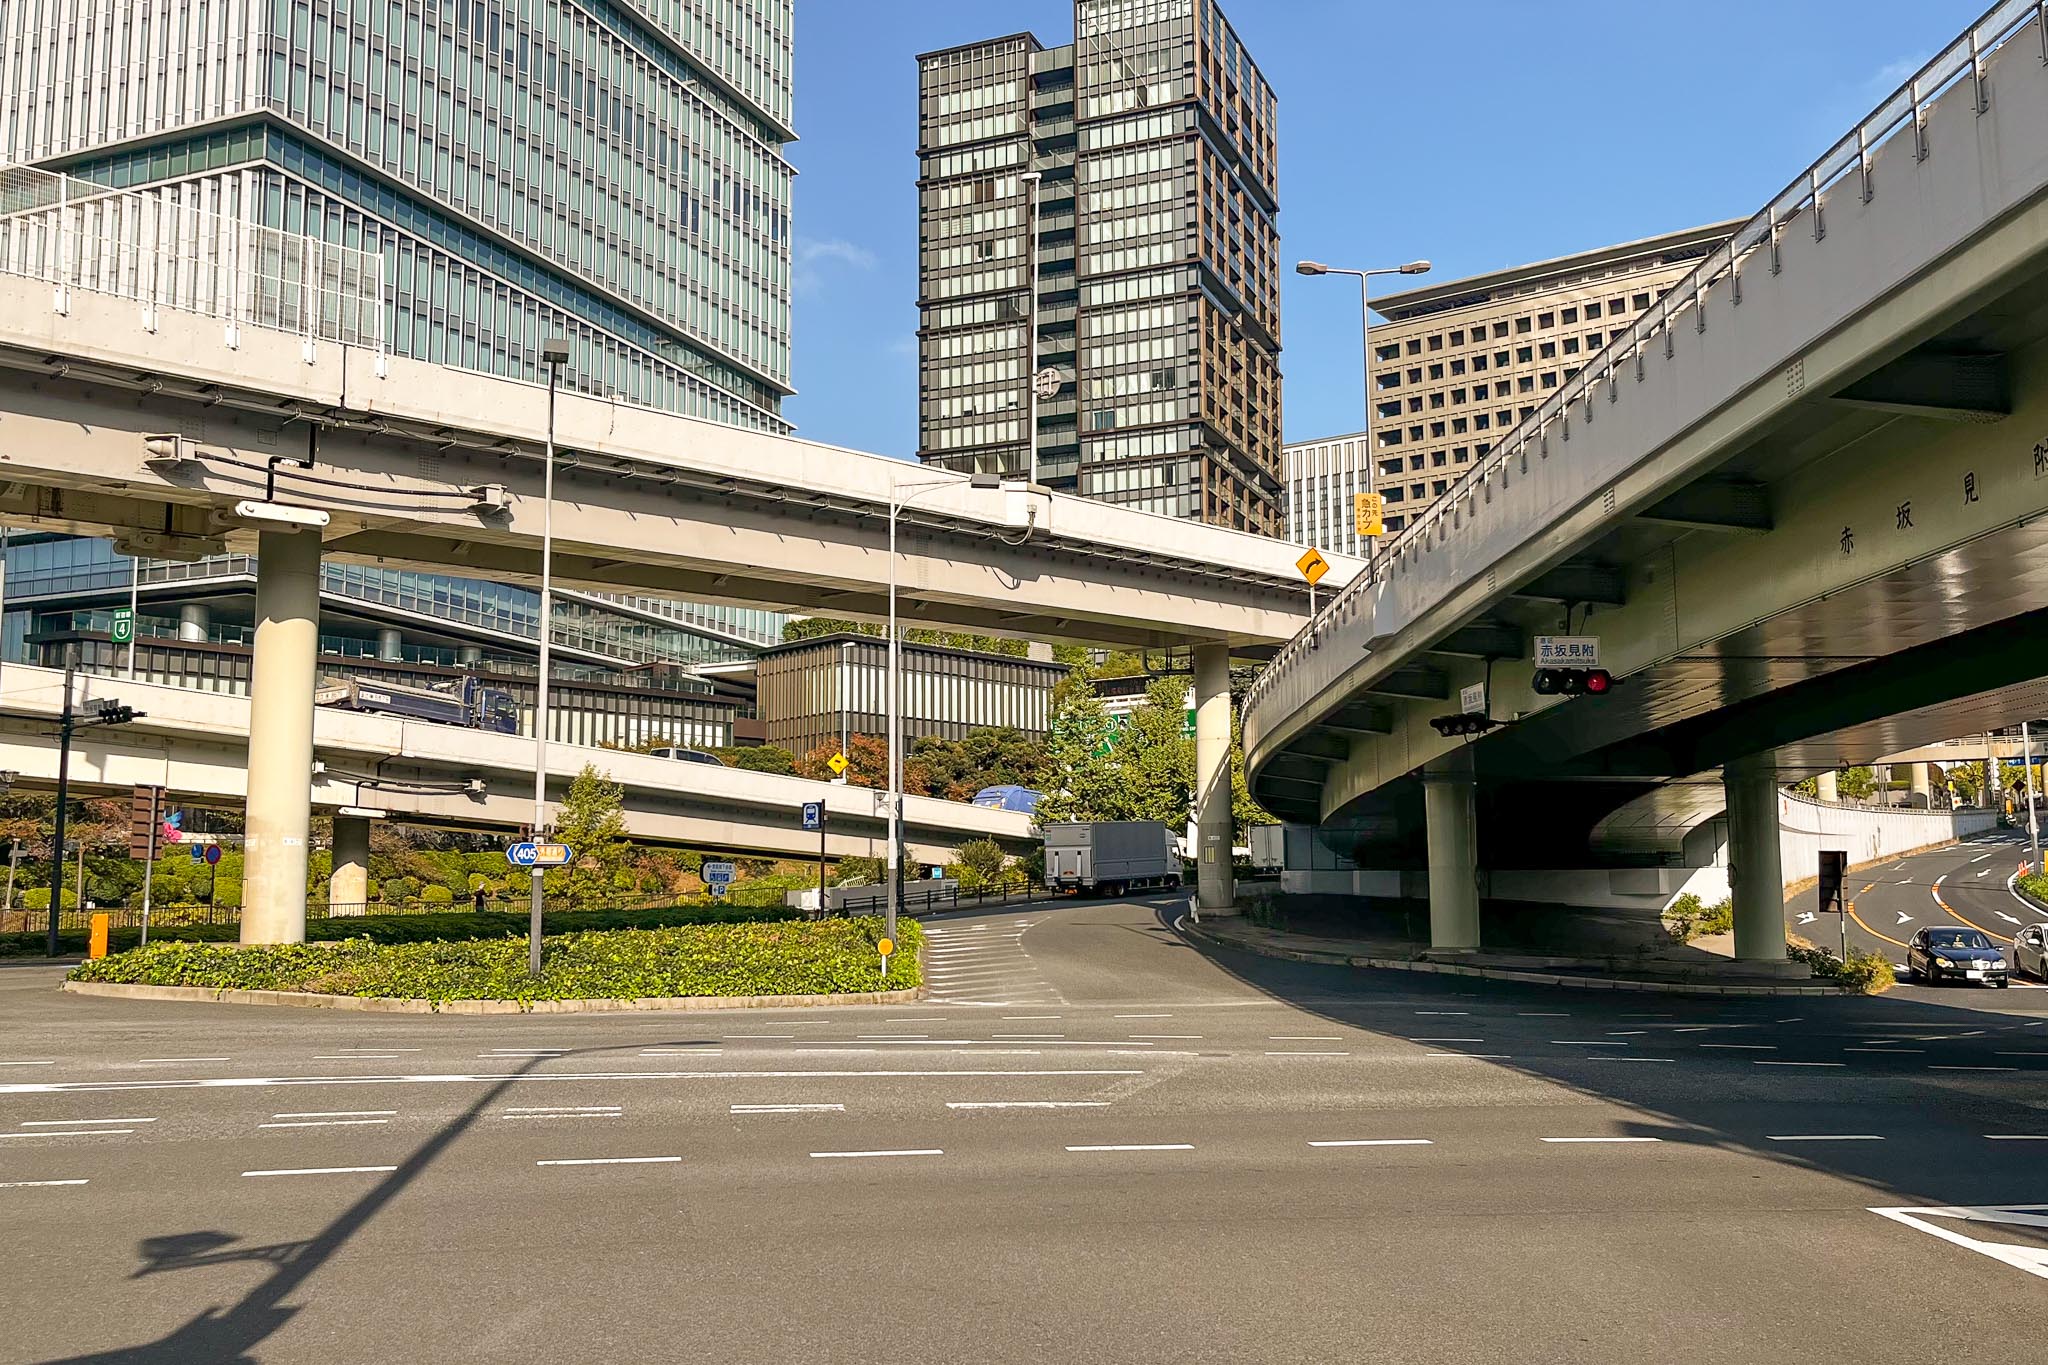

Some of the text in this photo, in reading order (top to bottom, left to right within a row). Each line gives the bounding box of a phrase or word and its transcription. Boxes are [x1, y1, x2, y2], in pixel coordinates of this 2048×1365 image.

[1540, 644, 1595, 657] 赤坂見附
[516, 847, 538, 860] 405
